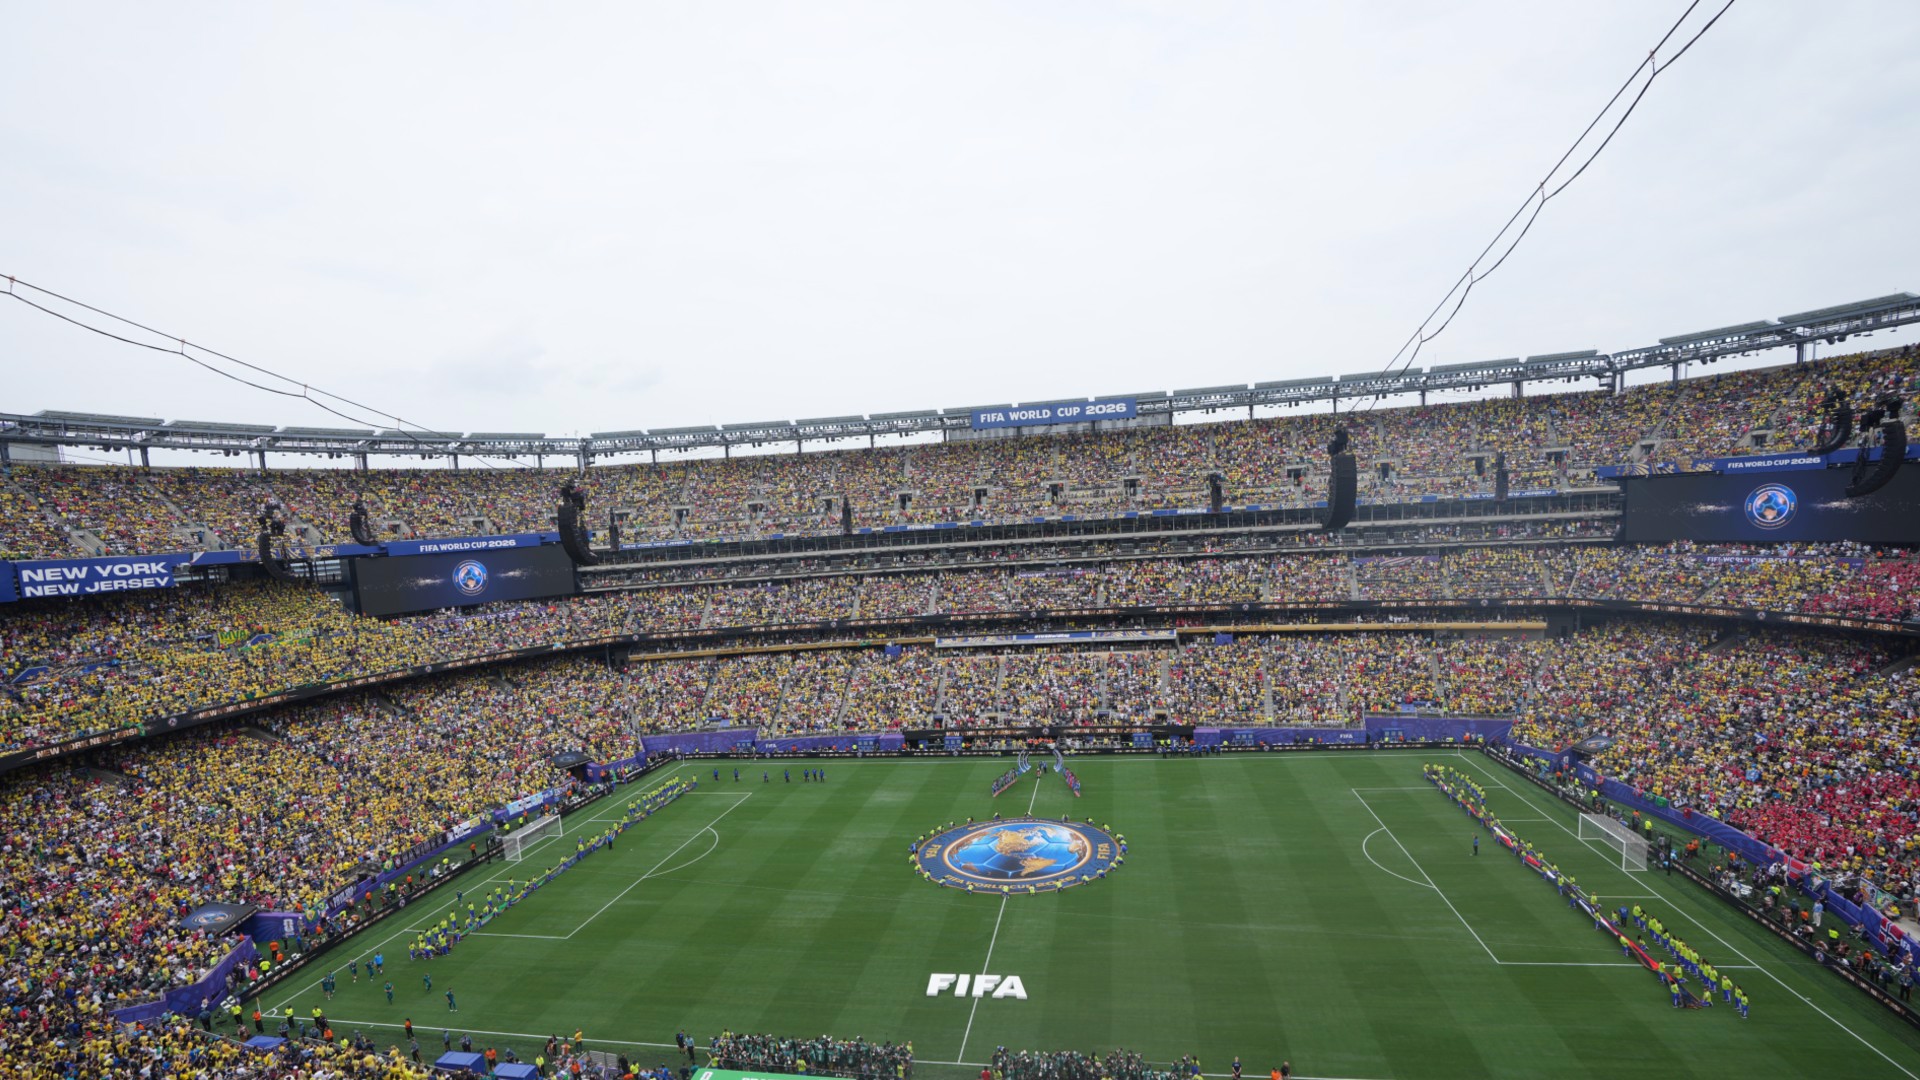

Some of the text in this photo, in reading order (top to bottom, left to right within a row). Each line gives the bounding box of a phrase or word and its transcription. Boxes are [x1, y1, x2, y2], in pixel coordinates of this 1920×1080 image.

[980, 403, 1127, 423] FIFA WORLD CUP 2026
[1745, 460, 1773, 468] WORLD
[1791, 457, 1821, 465] 2026
[440, 543, 469, 551] WORLD
[471, 541, 488, 549] CUP
[488, 539, 516, 547] 2026
[21, 562, 169, 582] NEW YORK
[25, 576, 170, 597] NEW JERSEY
[1840, 619, 1863, 629] NEW
[1864, 622, 1903, 633] JERSEY
[926, 973, 1028, 1000] FIFA
